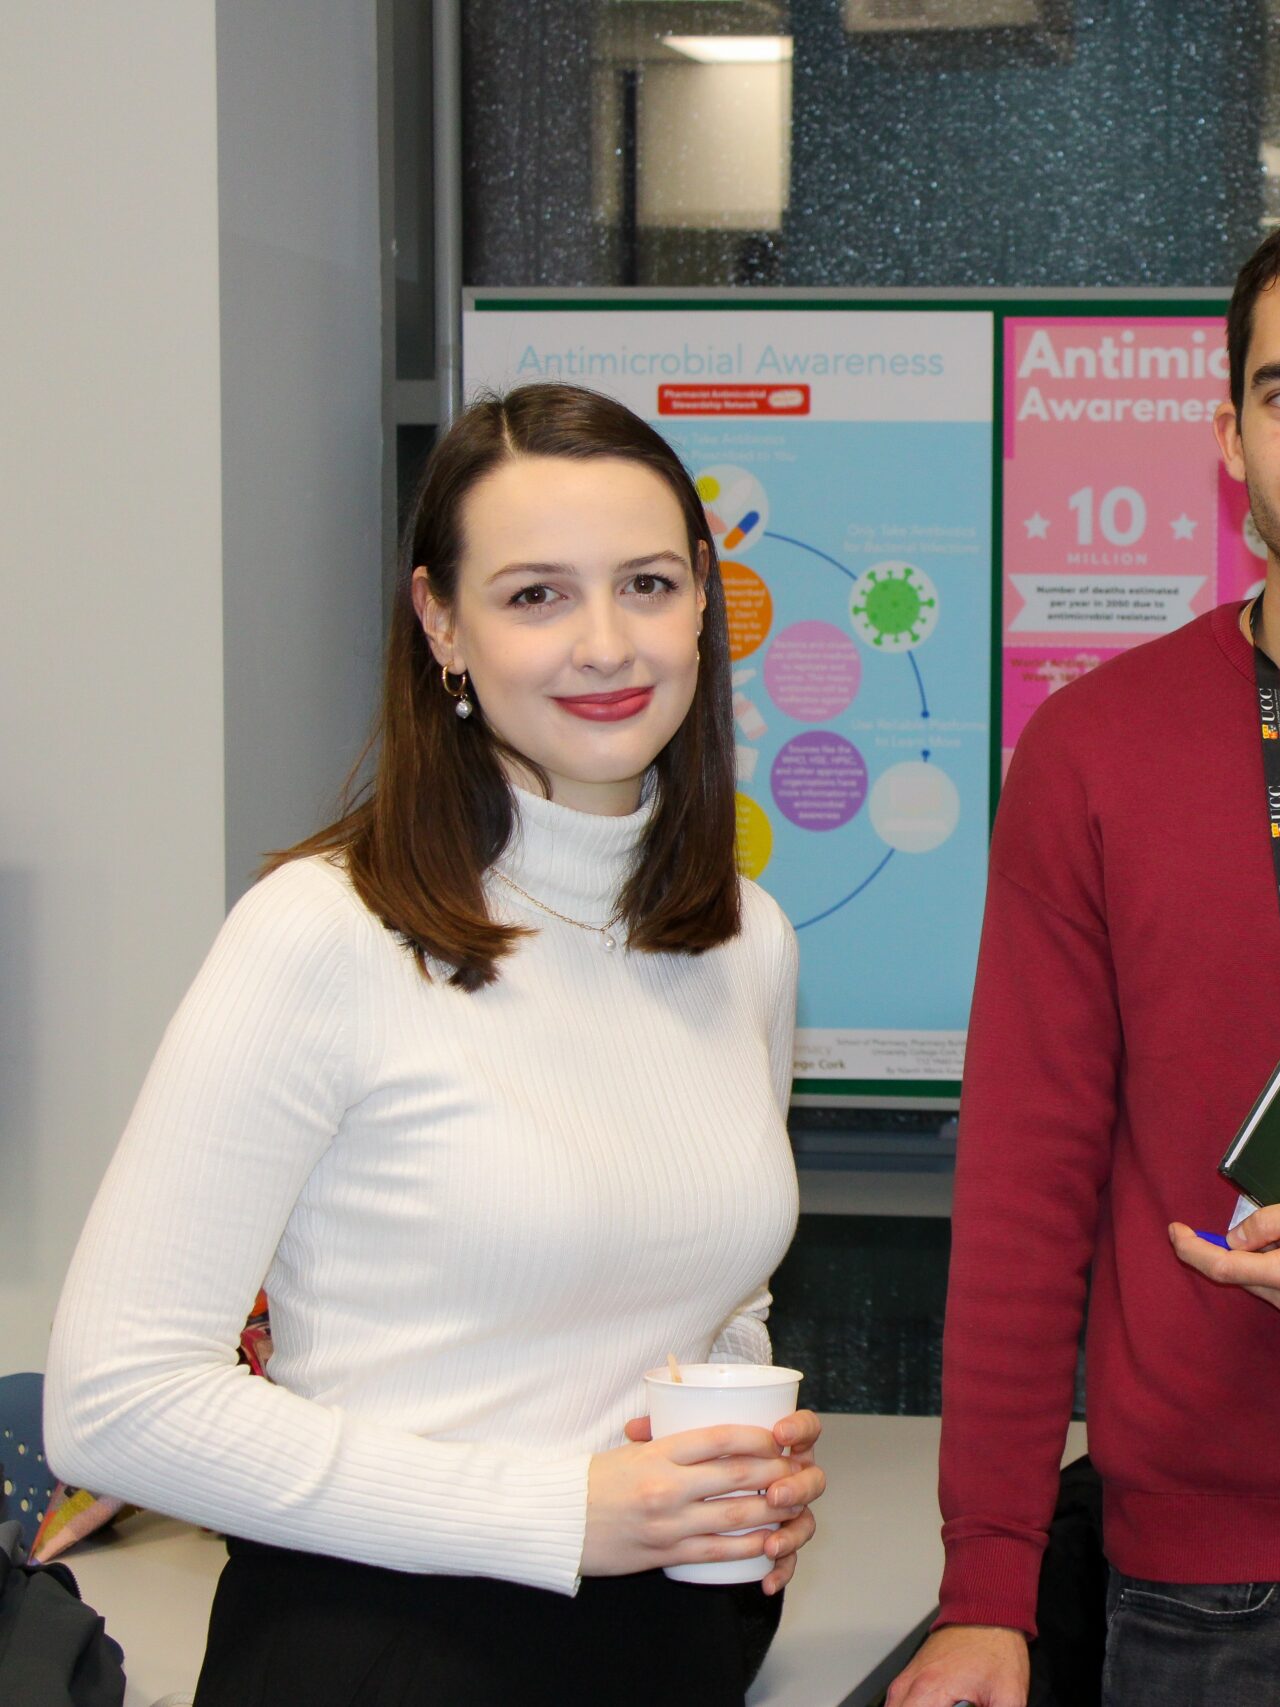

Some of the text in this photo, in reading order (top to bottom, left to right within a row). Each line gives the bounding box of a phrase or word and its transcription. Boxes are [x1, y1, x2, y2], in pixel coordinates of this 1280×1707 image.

[514, 343, 945, 377] Antimicrobial Awareness
[1017, 329, 1230, 379] Antimic
[1017, 386, 1218, 422] Awarenes
[1067, 485, 1147, 547] 10
[1067, 553, 1147, 566] MILLION
[1036, 586, 1077, 595] Number
[1091, 586, 1127, 595] deaths
[1128, 586, 1180, 596] estimated
[1259, 687, 1277, 722] UCC
